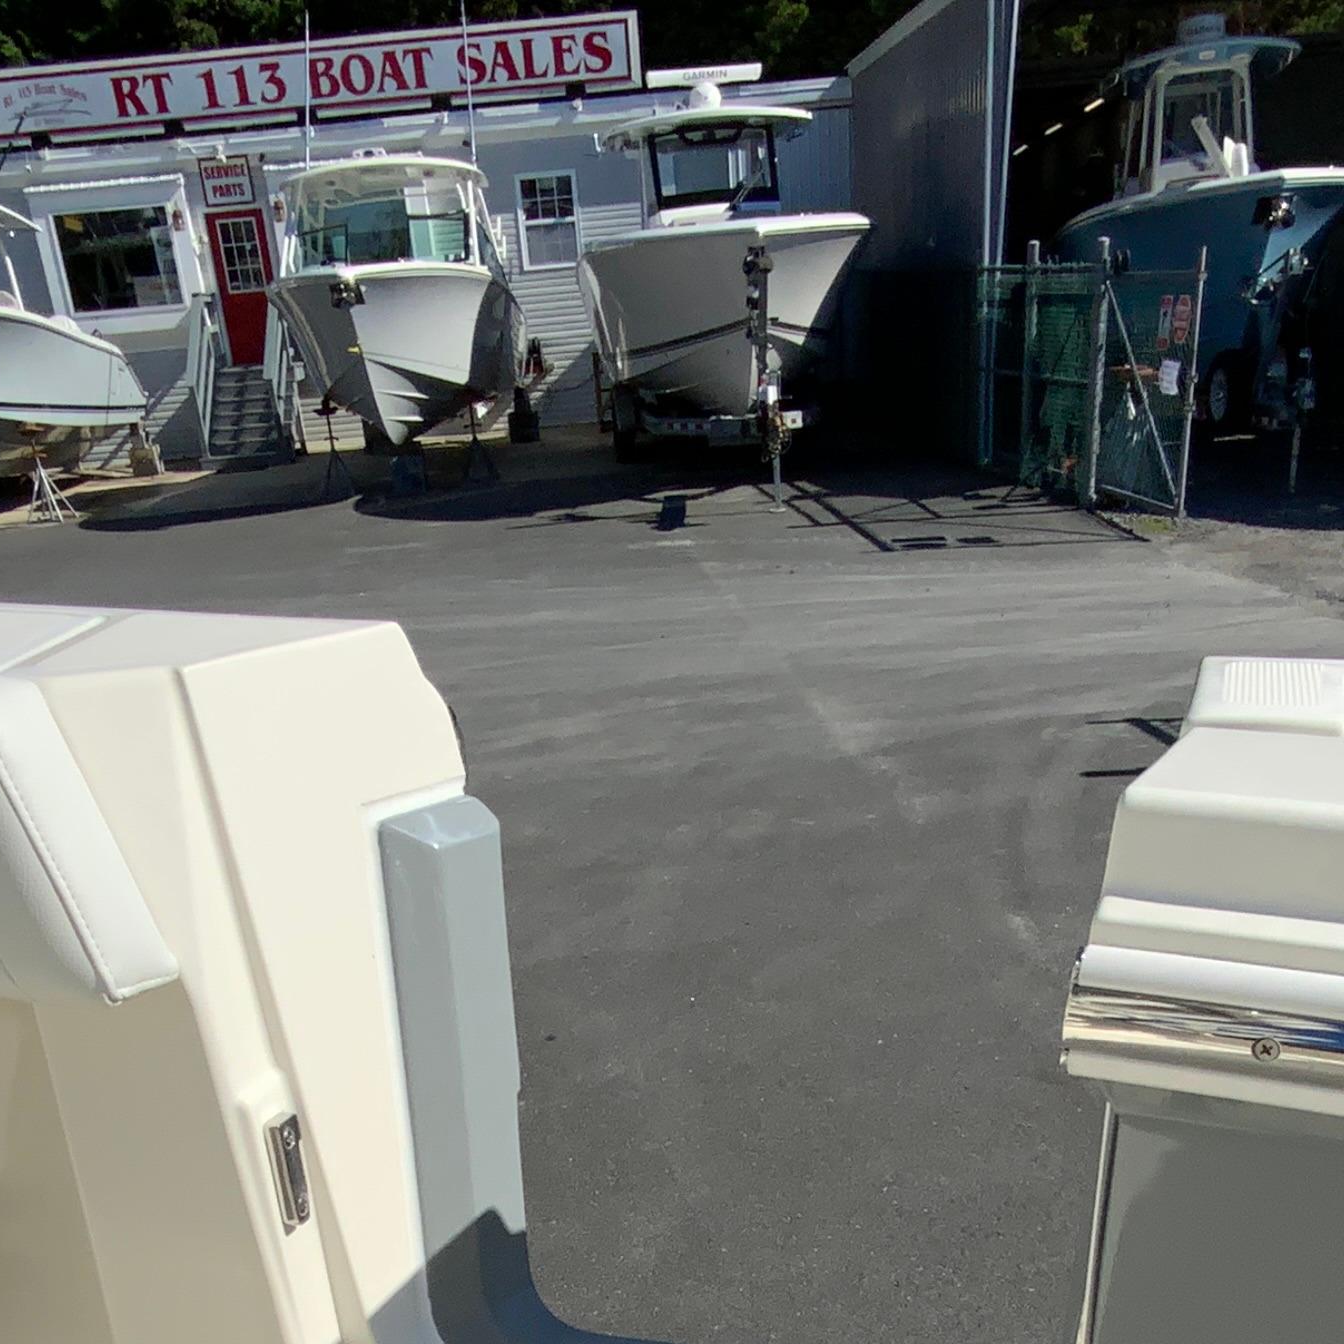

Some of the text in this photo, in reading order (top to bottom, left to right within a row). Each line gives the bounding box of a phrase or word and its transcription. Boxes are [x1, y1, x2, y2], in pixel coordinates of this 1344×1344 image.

[109, 31, 613, 118] RT 113 BOAT SALES
[683, 69, 727, 82] GARMIN
[203, 163, 247, 180] SERVICE
[211, 183, 246, 199] PARTS
